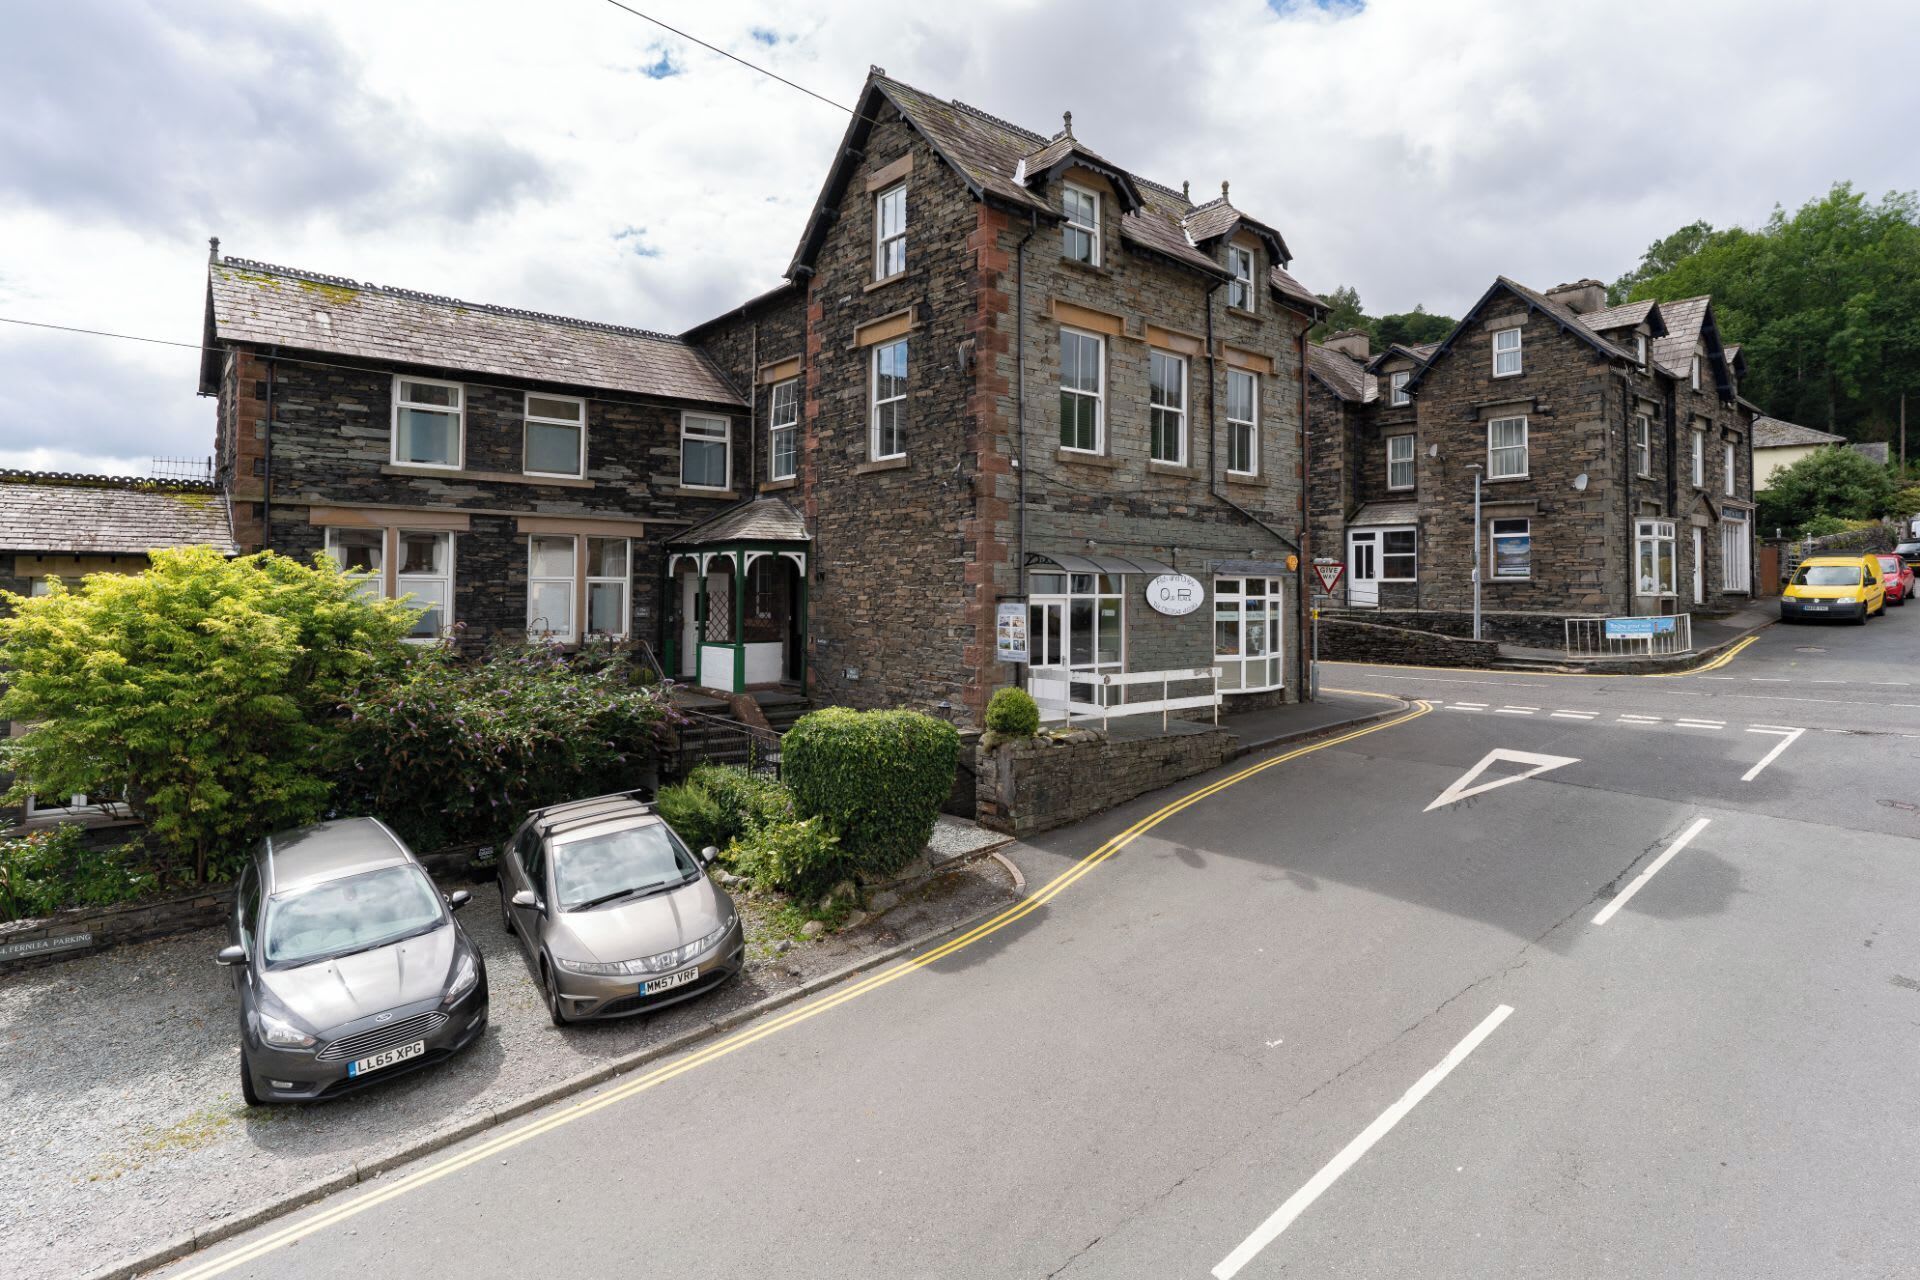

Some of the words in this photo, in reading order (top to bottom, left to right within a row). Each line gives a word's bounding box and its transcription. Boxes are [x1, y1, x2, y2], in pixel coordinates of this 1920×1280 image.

[9, 941, 48, 953] FERNLEA
[53, 933, 91, 946] PARKING
[646, 976, 674, 992] MM57
[677, 968, 697, 983] VRF
[357, 1051, 393, 1073] LL65
[396, 1042, 421, 1061] XPG
